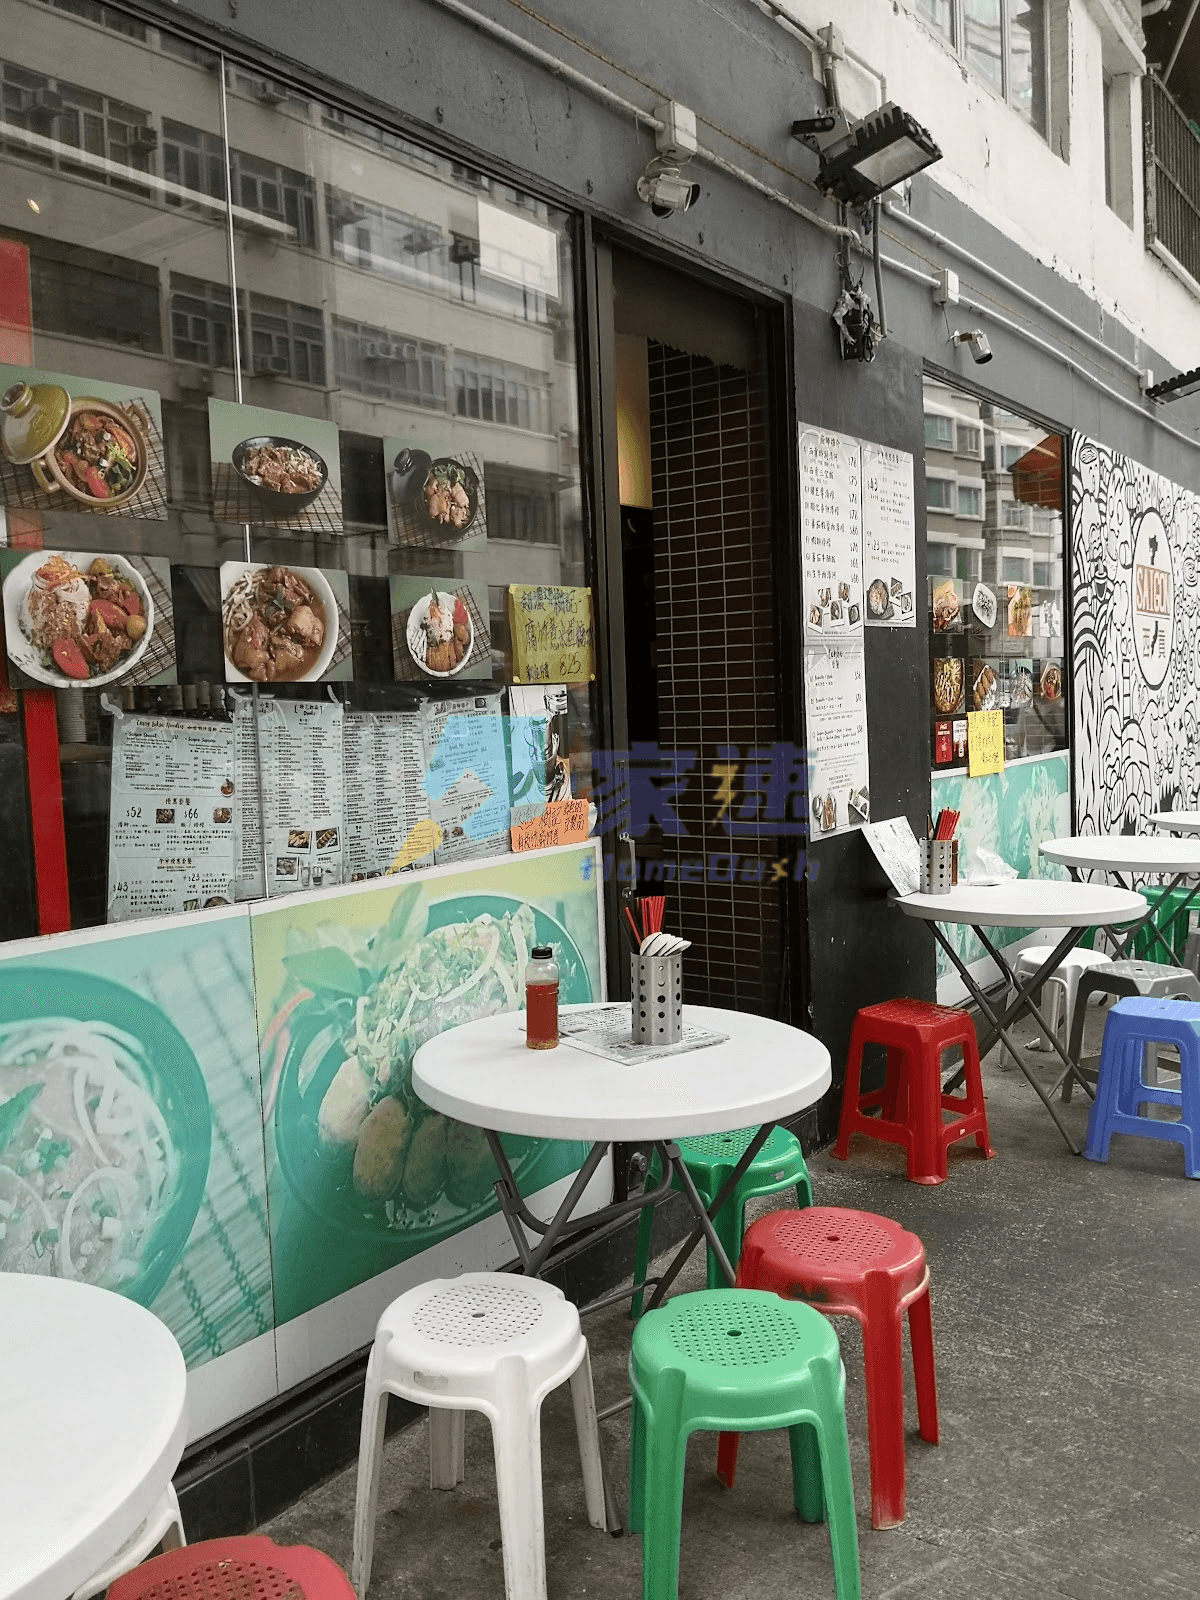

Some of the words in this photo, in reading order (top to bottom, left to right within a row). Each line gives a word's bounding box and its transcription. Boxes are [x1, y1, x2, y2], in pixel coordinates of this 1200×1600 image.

[126, 806, 142, 819] $52
[184, 807, 199, 819] $66
[113, 881, 129, 892] $43
